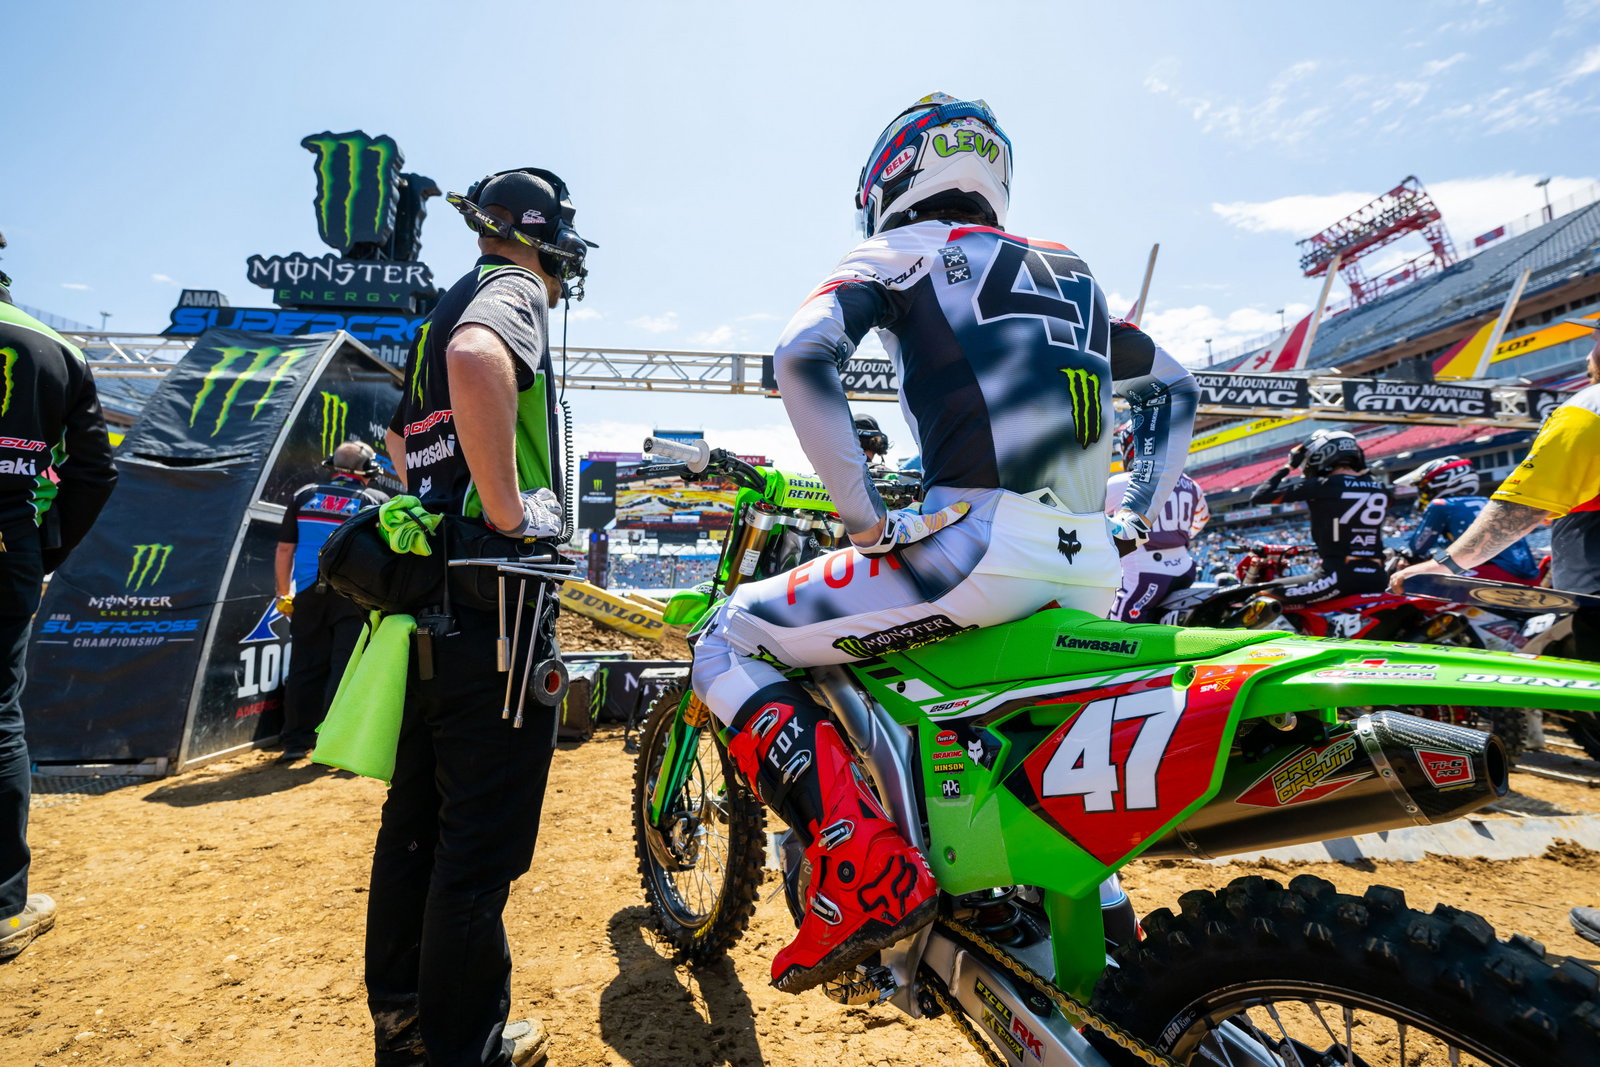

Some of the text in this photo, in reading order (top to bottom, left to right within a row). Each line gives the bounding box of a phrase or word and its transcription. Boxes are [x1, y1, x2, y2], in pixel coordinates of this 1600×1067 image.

[932, 129, 1000, 164] LEVI
[885, 151, 912, 176] BELL
[474, 212, 495, 225] MATT
[251, 257, 429, 288] MONSTER
[183, 291, 219, 308] AMA
[279, 289, 401, 303] ENERGY
[971, 238, 1110, 362] 47
[1195, 376, 1298, 391] OCKY MOUNTAIN
[1376, 383, 1485, 400] ROCKY MOUNTAIN
[1149, 406, 1159, 431] BRAKING
[1143, 437, 1153, 455] RK
[303, 493, 361, 515] AMA
[787, 488, 832, 502] RENTH
[1340, 491, 1388, 526] 78
[1164, 558, 1182, 568] FLY
[88, 595, 173, 610] MONSTER
[564, 587, 664, 631] DUNLOP
[50, 613, 72, 621] AMA
[39, 619, 201, 635] SUPERCROSS
[862, 618, 951, 650] MONSTER
[72, 636, 165, 648] CHAMPIONSHIP
[1055, 634, 1139, 655] Kawasaki
[1199, 679, 1237, 693] SMX
[768, 716, 804, 769] FOX
[1042, 683, 1189, 814] 47
[932, 750, 963, 760] BRAKING
[934, 763, 964, 772] HINSON
[1274, 752, 1317, 789] PRO
[1277, 744, 1355, 803] CIRCUIT
[1436, 768, 1461, 778] PRO
[942, 779, 960, 796] PPG
[976, 981, 1011, 1021] EXCEL
[1012, 1016, 1044, 1058] RK
